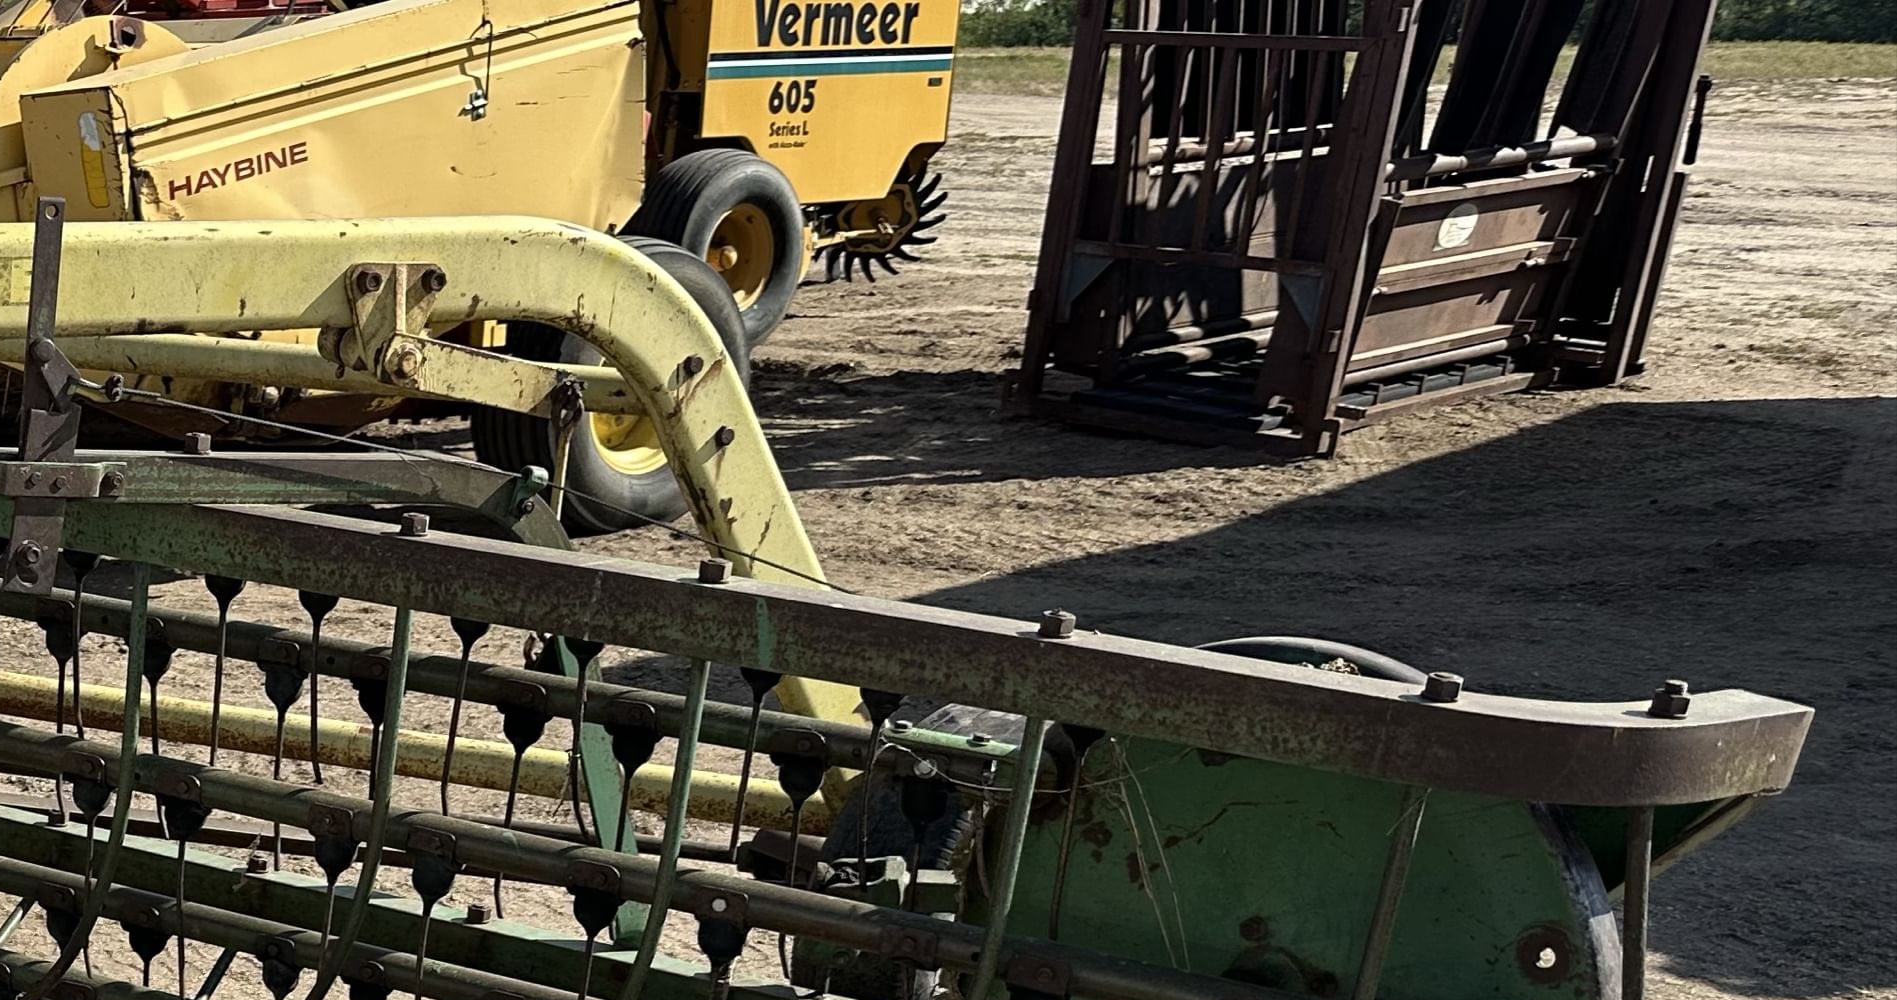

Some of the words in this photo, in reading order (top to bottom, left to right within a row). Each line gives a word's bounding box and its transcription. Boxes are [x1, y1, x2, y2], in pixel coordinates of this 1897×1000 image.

[755, 0, 920, 47] Vermeer
[768, 79, 818, 114] 605
[769, 121, 801, 137] Series
[802, 120, 809, 136] L
[168, 141, 309, 201] HAYBINE
